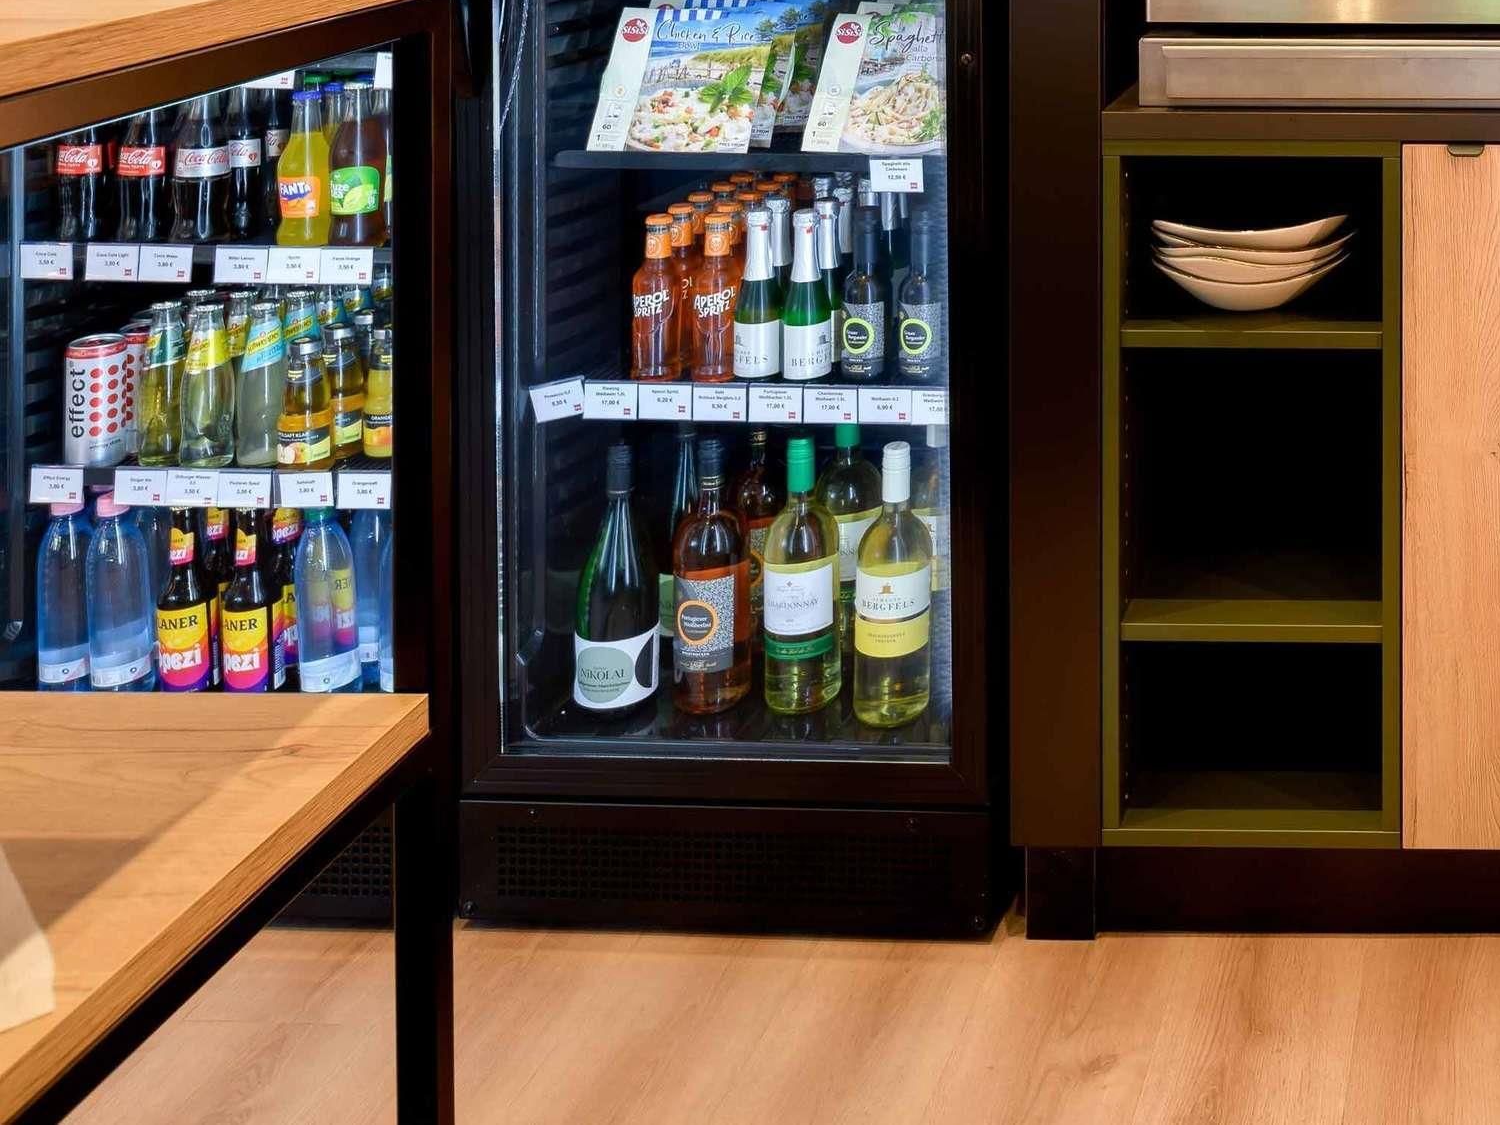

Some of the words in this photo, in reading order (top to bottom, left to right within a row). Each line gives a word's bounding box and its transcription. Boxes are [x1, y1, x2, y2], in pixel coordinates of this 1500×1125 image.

[656, 18, 707, 42] Chicken
[719, 24, 756, 43] Rice
[694, 286, 736, 309] APEROL
[698, 299, 730, 318] SPRITZ
[71, 368, 86, 439] effect
[158, 614, 198, 631] LANER
[158, 645, 202, 673] pezi
[224, 648, 260, 673] pezi
